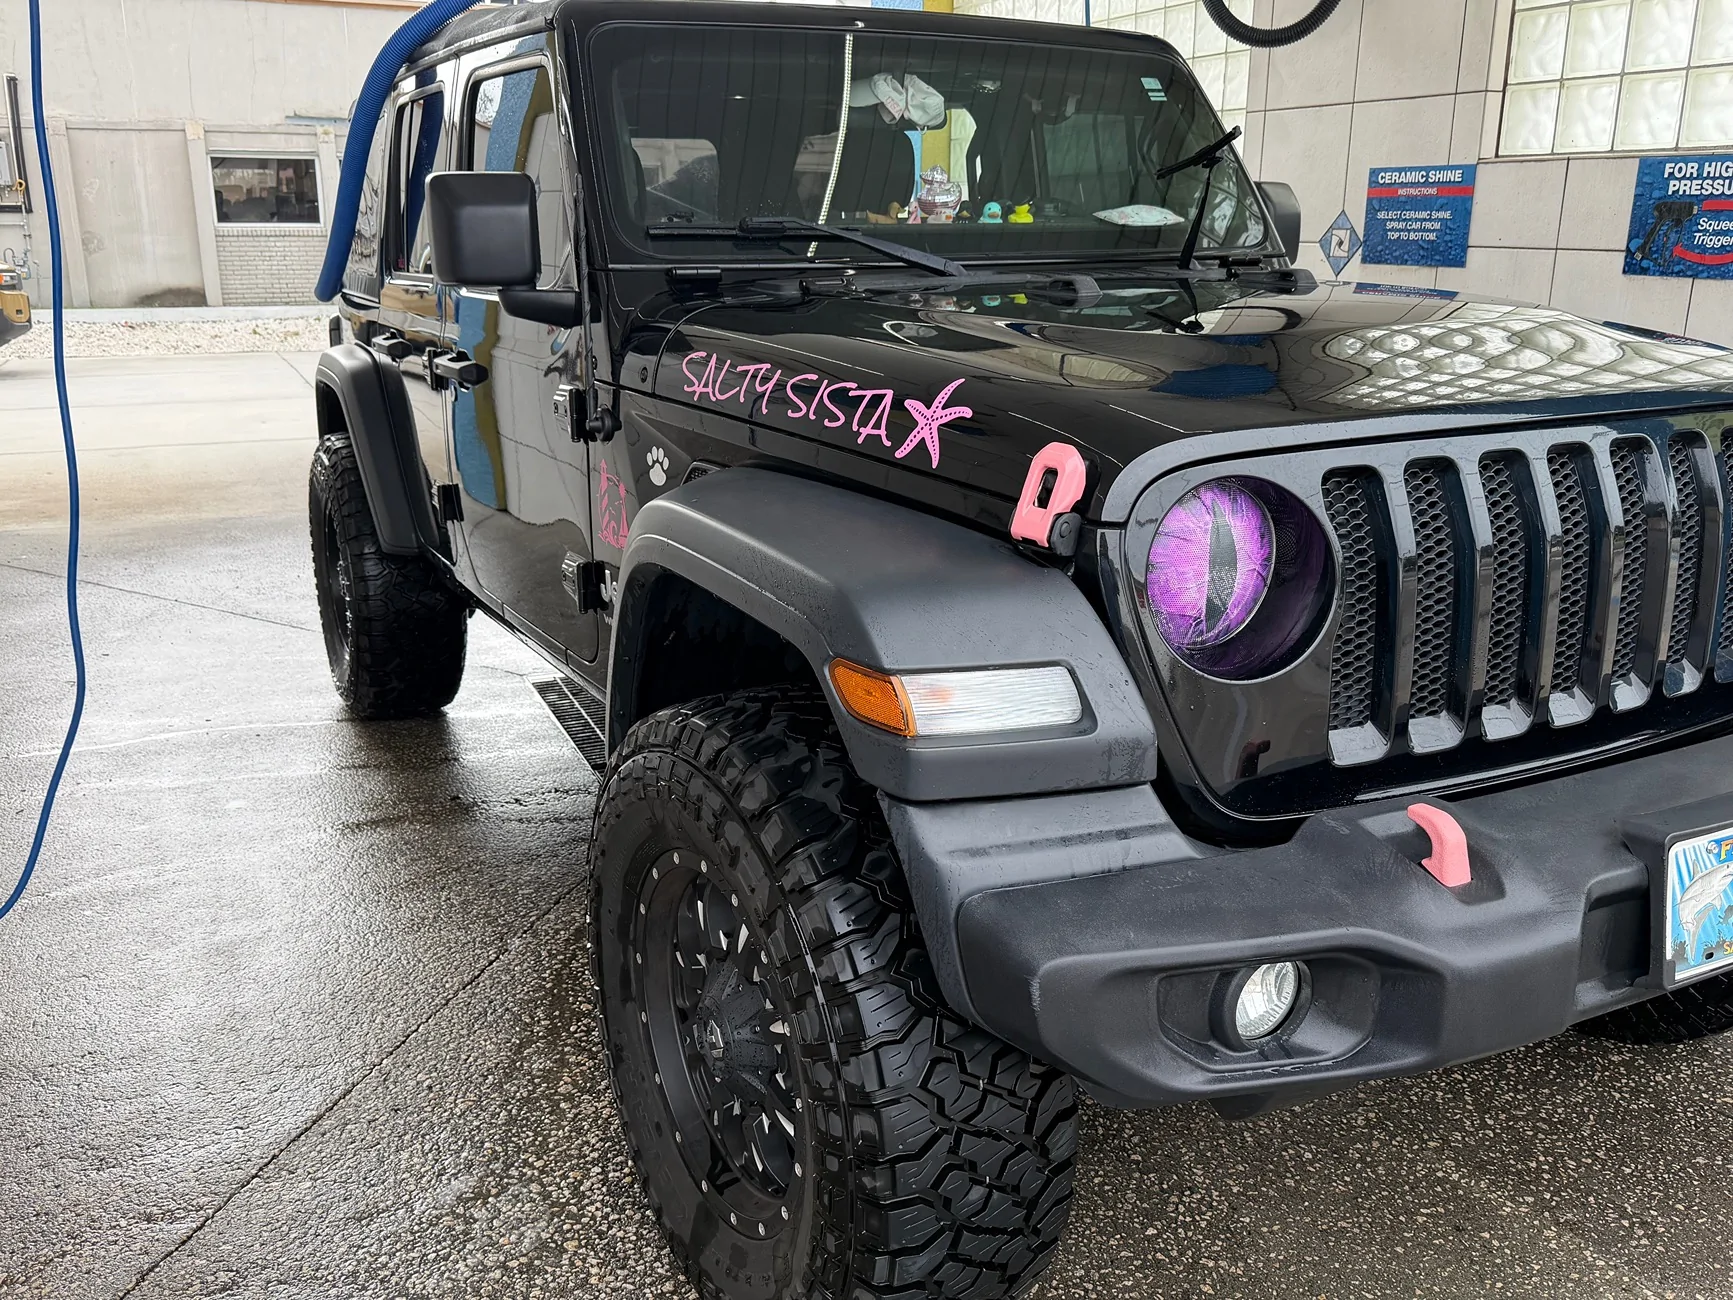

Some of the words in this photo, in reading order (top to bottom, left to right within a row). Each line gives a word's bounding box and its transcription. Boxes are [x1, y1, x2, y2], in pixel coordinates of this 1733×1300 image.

[1664, 162, 1699, 178] FOR
[1378, 170, 1427, 184] CERAMIC
[1428, 169, 1463, 182] SHINE
[1397, 187, 1438, 195] INSTRUCTIONS
[1377, 211, 1401, 219] SELECT
[1401, 211, 1431, 219] CERAMIC
[1431, 211, 1453, 219] SHINE.
[1386, 221, 1407, 229] SPRAY
[1407, 221, 1421, 229] CAR
[1421, 221, 1441, 229] FROM
[1387, 232, 1400, 240] TOP
[1400, 232, 1409, 240] TO
[1409, 232, 1437, 240] BOTTOM.
[681, 351, 782, 415] SALTY
[785, 373, 895, 447] SISTA
